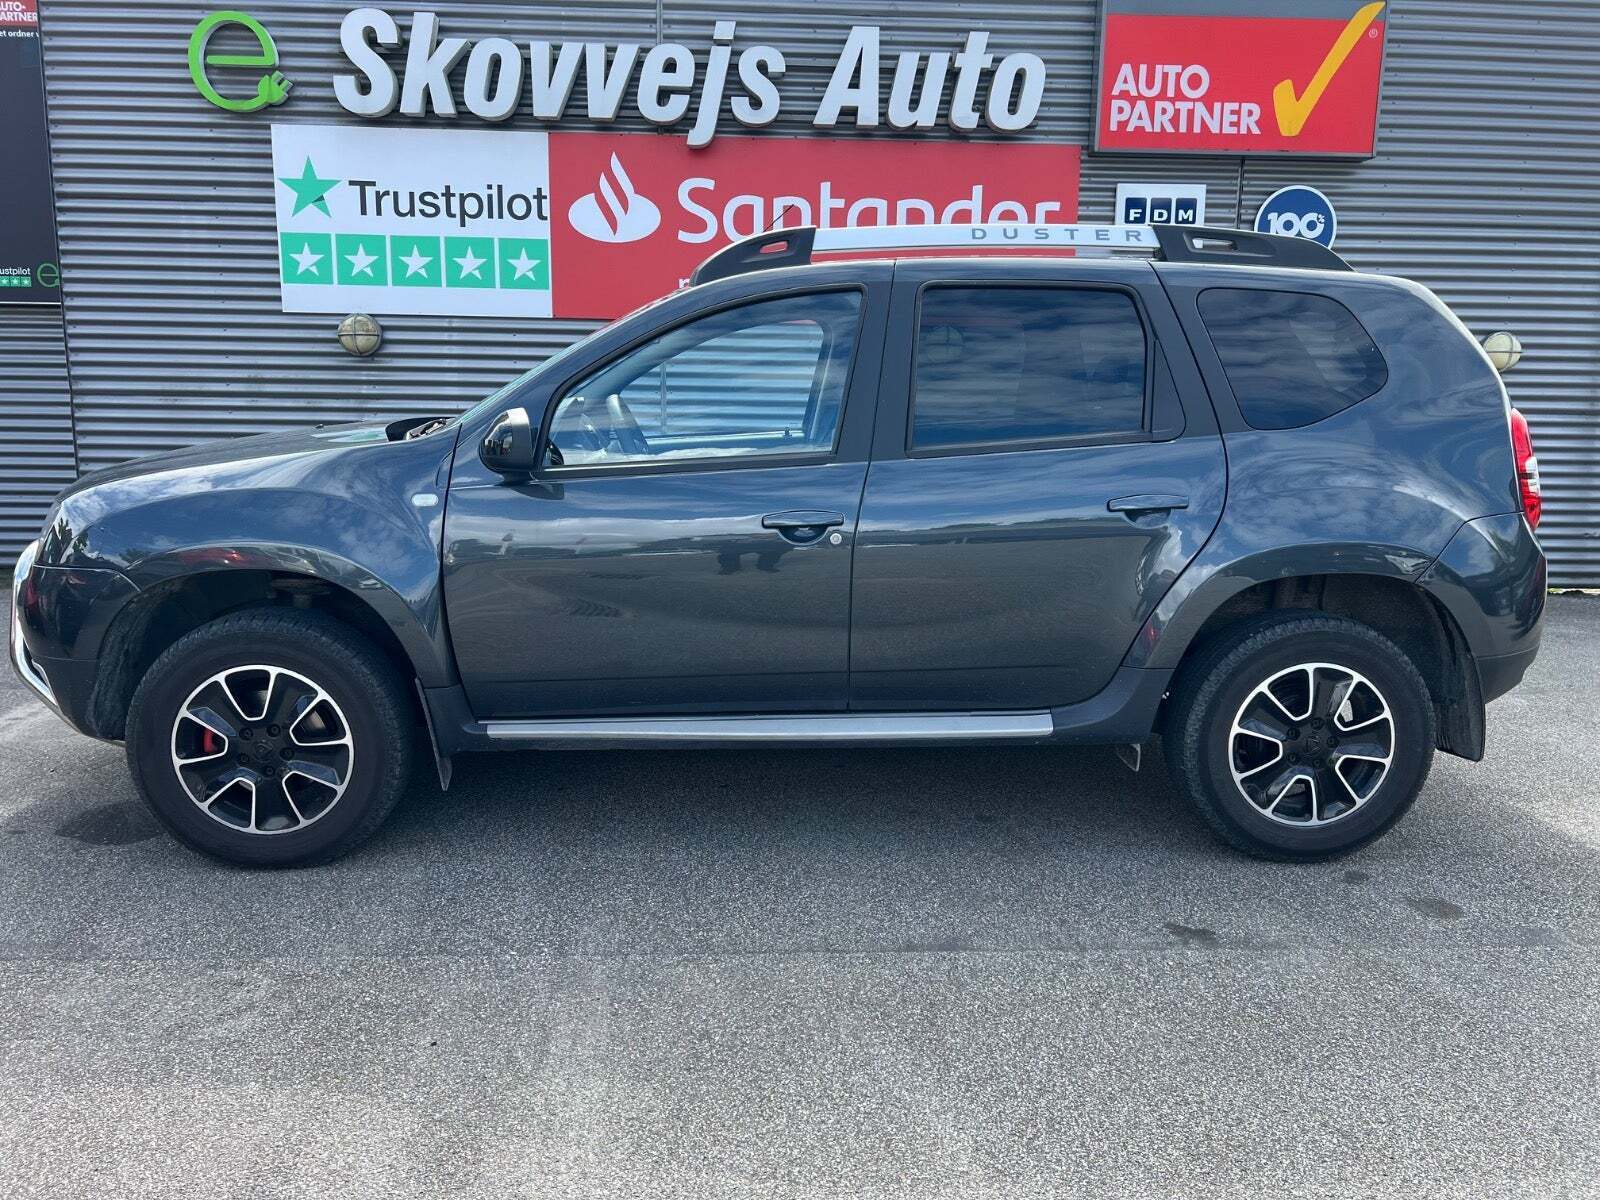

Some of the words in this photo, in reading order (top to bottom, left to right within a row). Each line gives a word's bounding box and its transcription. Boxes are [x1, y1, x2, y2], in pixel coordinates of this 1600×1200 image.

[0, 1, 26, 11] UTO-
[0, 11, 38, 21] ARTNER
[8, 29, 34, 37] ordner
[333, 7, 786, 149] Skovvejs
[813, 26, 1046, 132] Auto
[1111, 63, 1210, 99] AUTO
[1109, 100, 1262, 135] PARTNER
[348, 179, 549, 227] Trustpilot
[1128, 208, 1194, 222] FDM
[971, 227, 1143, 242] DUSTER
[0, 266, 31, 276] ustpilot
